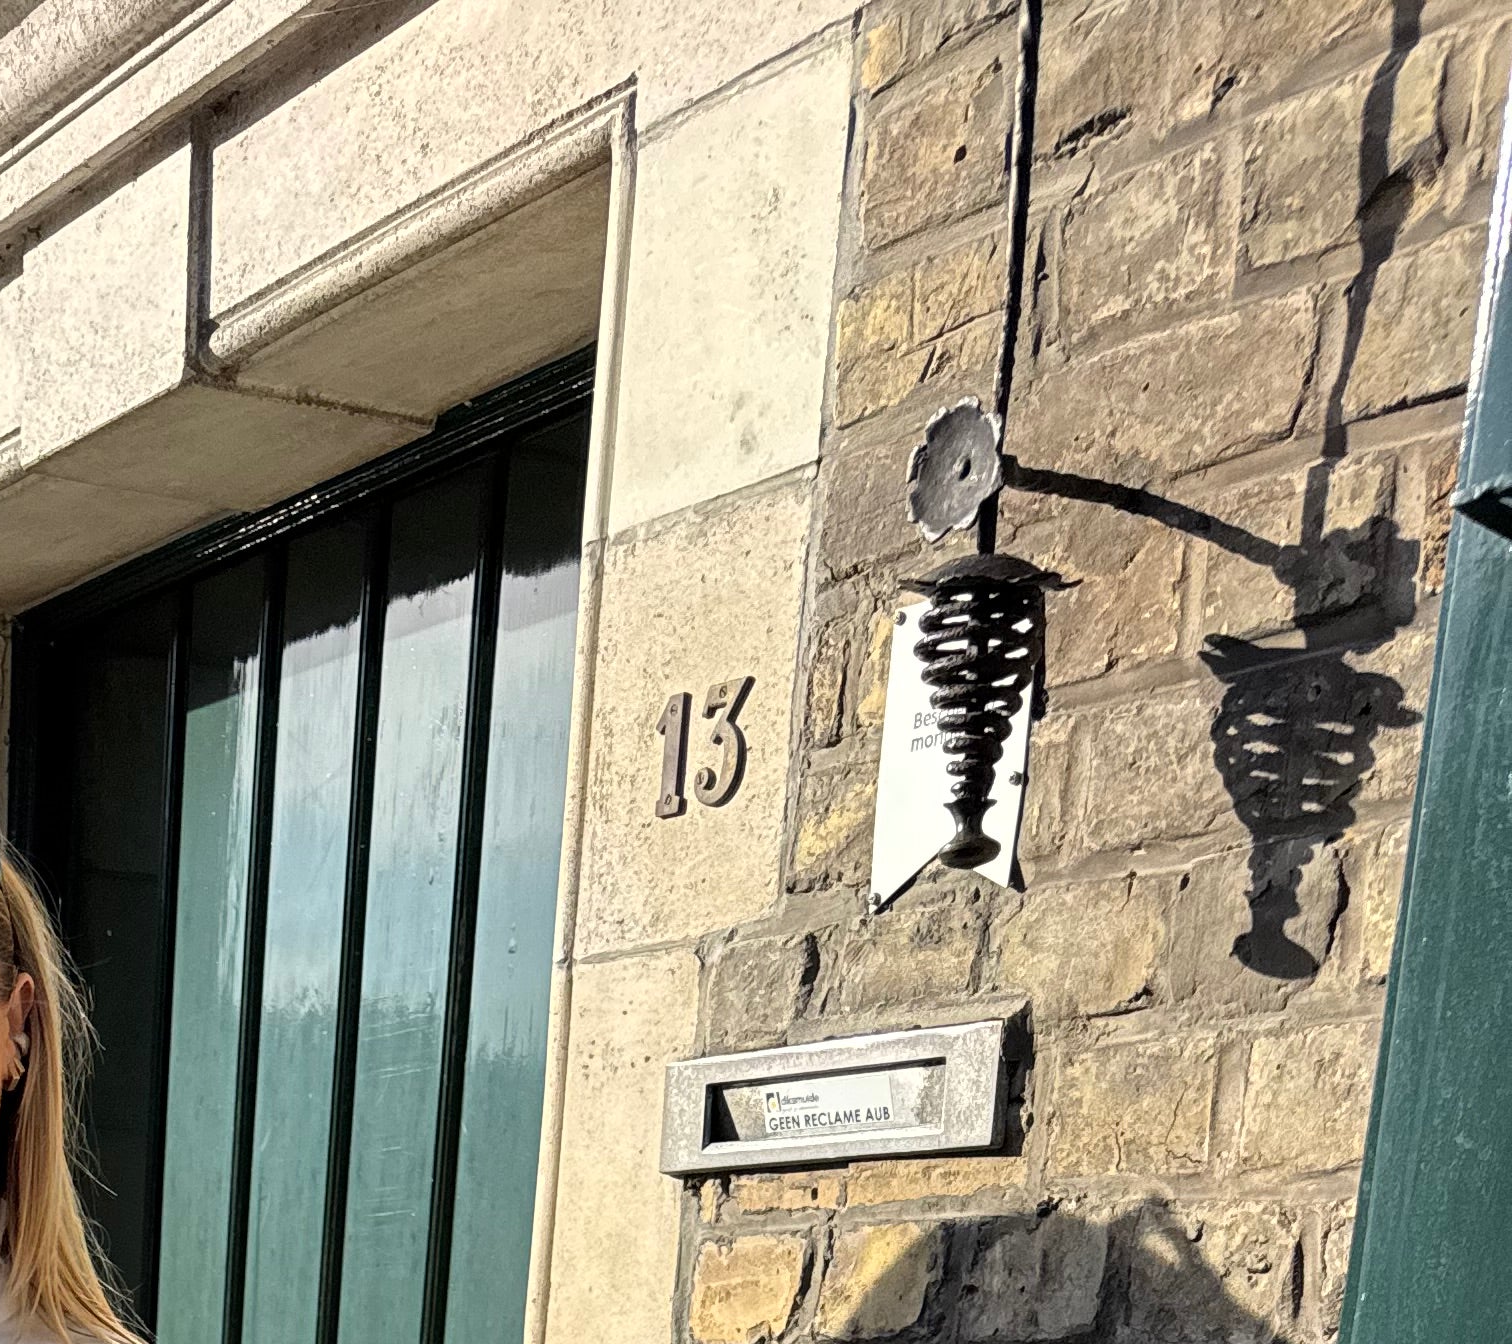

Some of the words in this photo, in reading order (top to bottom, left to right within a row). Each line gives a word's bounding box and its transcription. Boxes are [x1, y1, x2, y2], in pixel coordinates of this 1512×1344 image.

[655, 676, 756, 819] 13
[769, 1115, 801, 1131] GEEN
[804, 1108, 862, 1127] RECLAME
[865, 1106, 891, 1121] AUB
